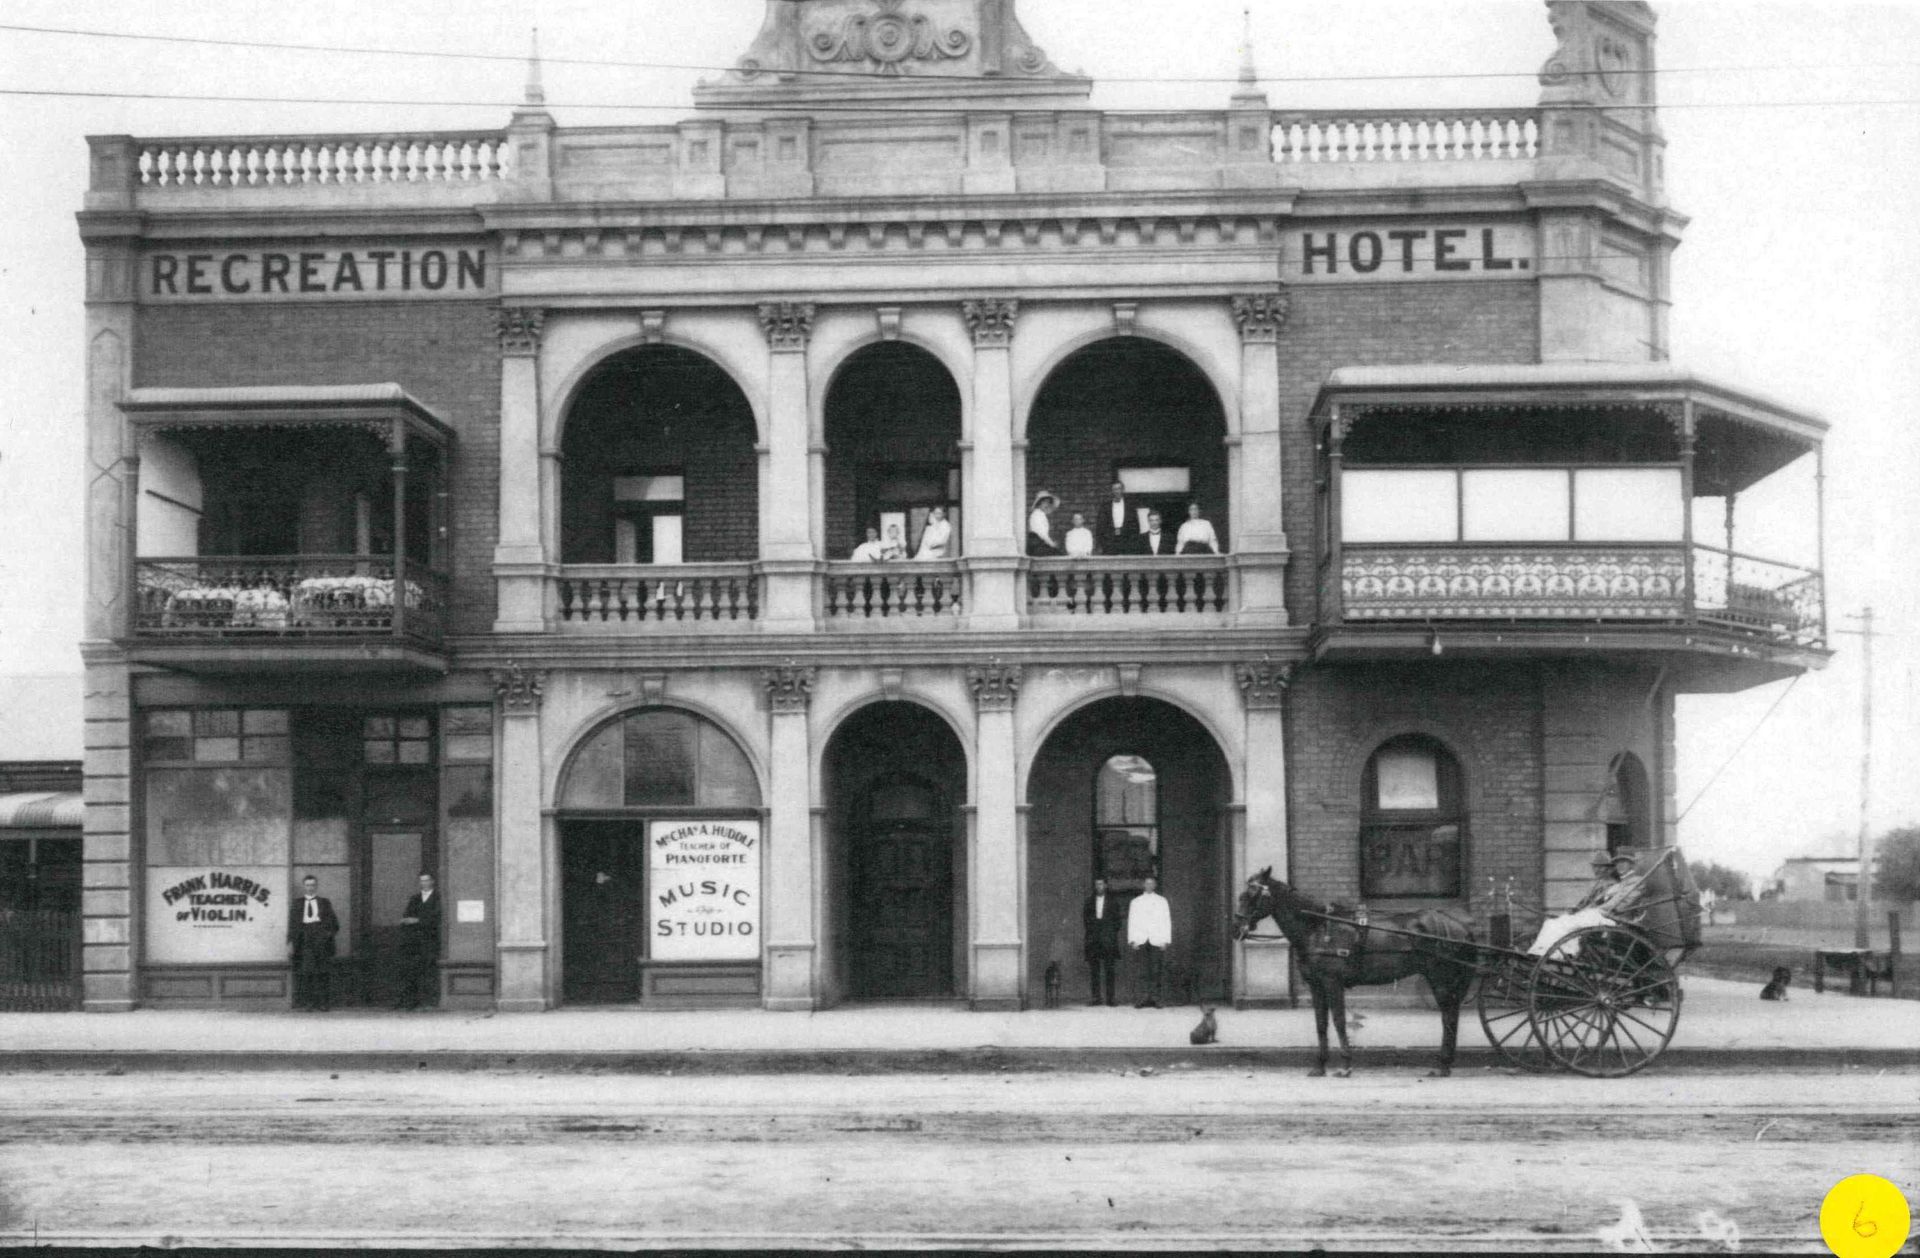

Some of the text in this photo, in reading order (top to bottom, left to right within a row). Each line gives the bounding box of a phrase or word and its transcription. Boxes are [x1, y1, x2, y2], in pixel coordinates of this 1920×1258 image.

[1302, 228, 1529, 274] HOTEL.
[152, 249, 487, 295] RECREATION
[665, 853, 747, 864] PIANOFORTE
[162, 872, 271, 907] FRANK HARRIS.
[189, 894, 248, 905] TEACHER
[658, 881, 751, 907] MUSIC
[190, 907, 253, 922] VIOLIN.
[657, 919, 753, 936] STUDIO
